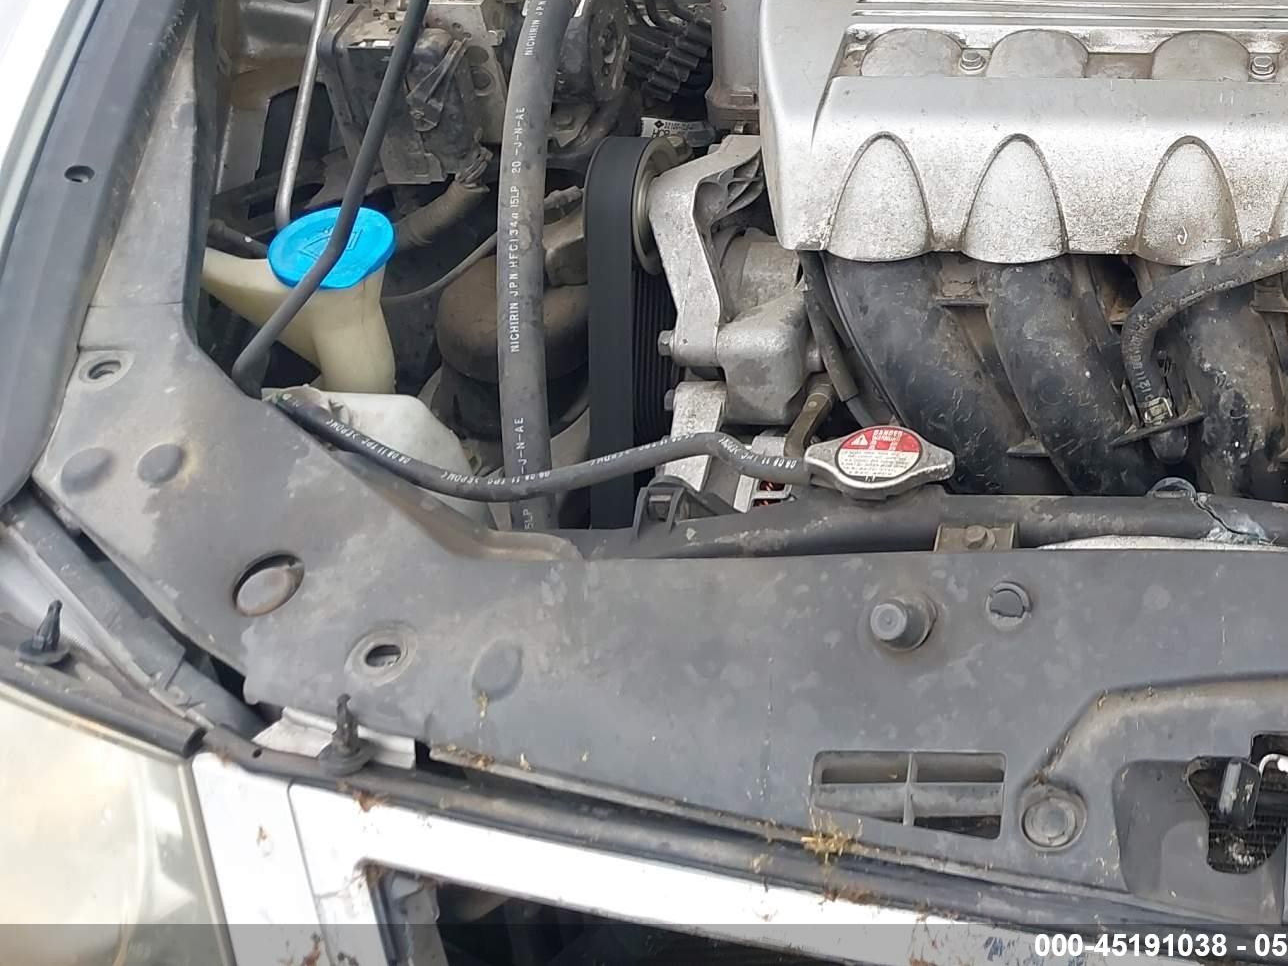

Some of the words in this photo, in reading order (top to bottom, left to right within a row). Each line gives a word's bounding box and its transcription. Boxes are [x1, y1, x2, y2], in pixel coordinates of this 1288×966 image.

[523, 19, 540, 56] NICHIRIN
[510, 160, 521, 174] 20
[508, 273, 519, 296] JPN
[508, 302, 520, 353] NICHIRIN
